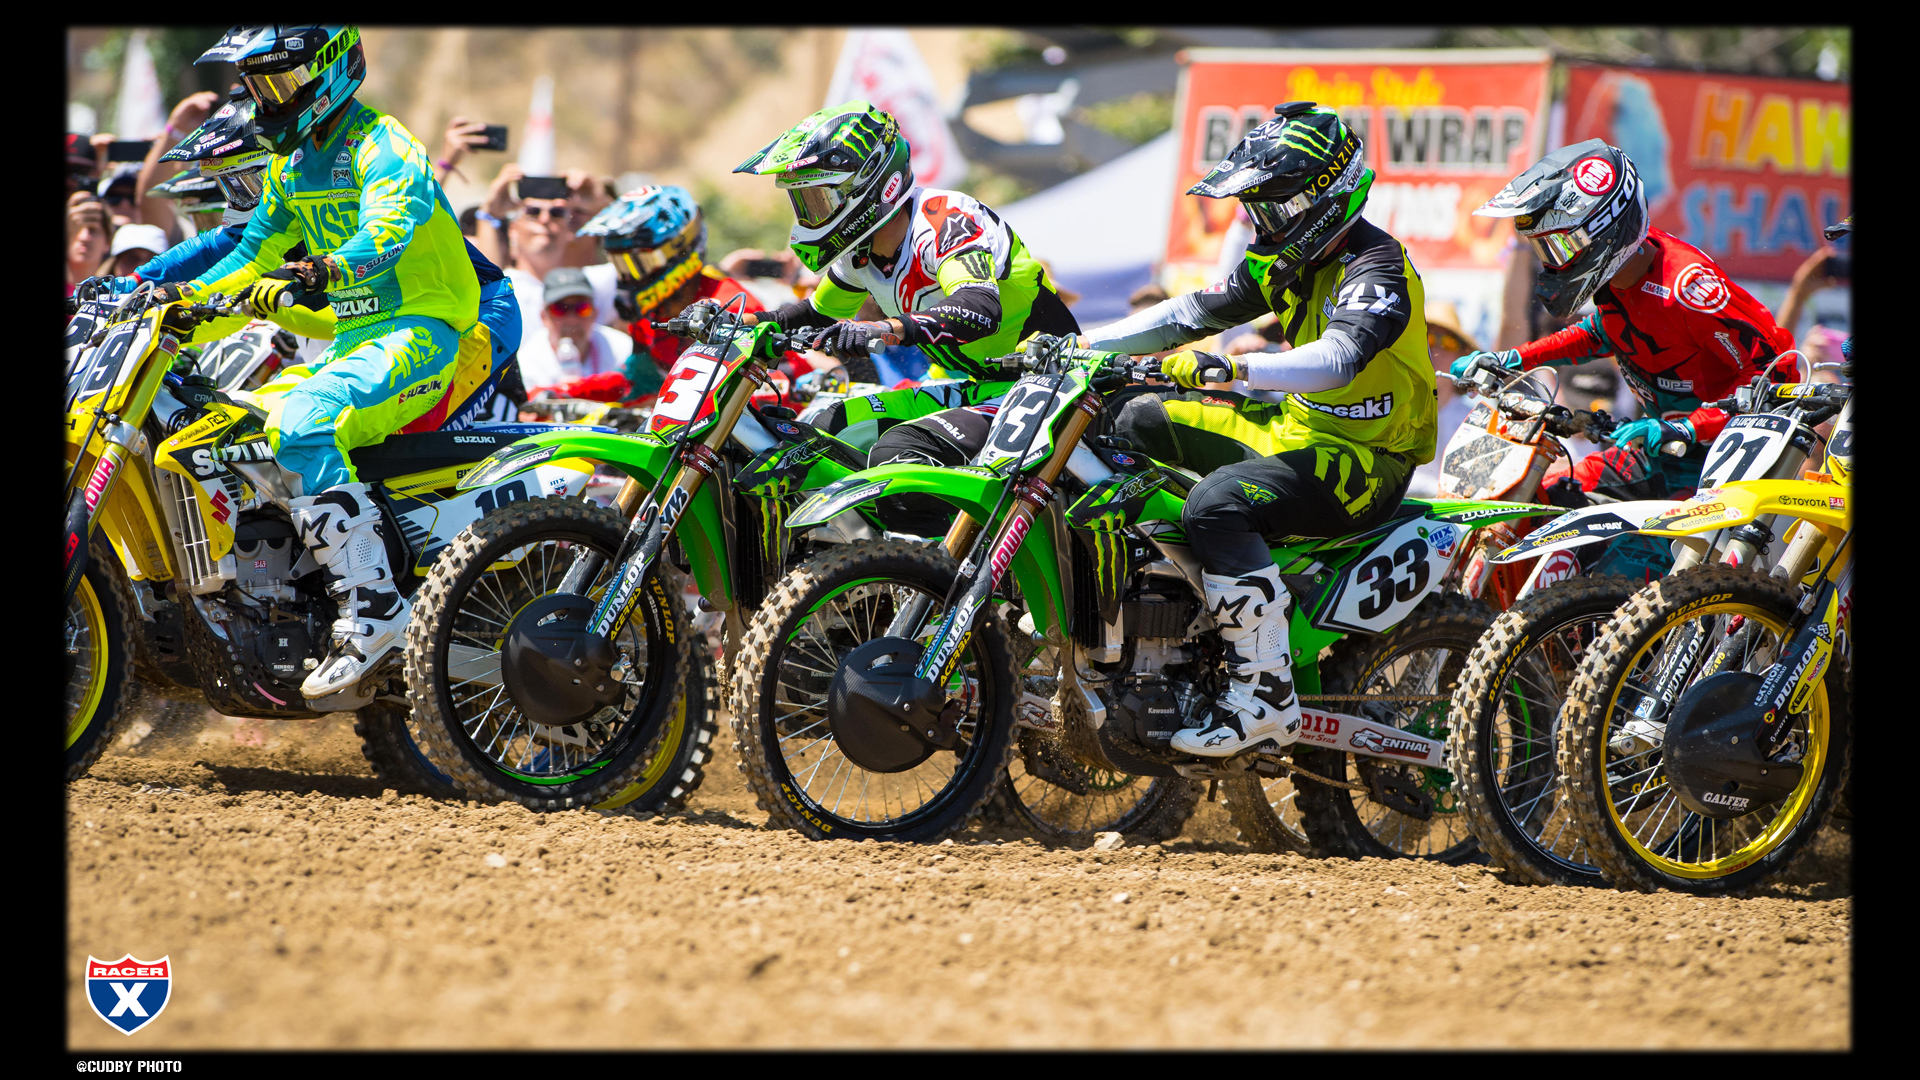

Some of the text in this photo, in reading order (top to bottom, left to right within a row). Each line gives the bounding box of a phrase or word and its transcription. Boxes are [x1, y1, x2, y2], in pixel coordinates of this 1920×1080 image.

[246, 51, 289, 66] SHIMANO
[201, 135, 226, 150] THOR
[1384, 107, 1531, 172] WRAP
[885, 176, 900, 199] BELL
[842, 203, 879, 236] MONSTER
[1297, 203, 1341, 245] MONSTER
[365, 243, 405, 271] SUZUKI
[929, 306, 992, 328] MONSTER
[939, 312, 982, 332] ENERGY
[704, 346, 719, 358] OIL
[405, 380, 442, 398] SUZUK
[1037, 376, 1051, 387] OIL
[1755, 417, 1770, 428] OIL
[453, 436, 496, 444] SUZUKI
[1700, 432, 1772, 490] 21
[85, 456, 117, 523] HOWA
[1791, 497, 1828, 508] TOYOTA
[1681, 513, 1725, 529] Autotrader
[1356, 537, 1431, 621] 33
[596, 551, 646, 638] DUNLOP
[649, 576, 675, 645] DUNLOP
[1664, 593, 1734, 625] DUNLOP
[925, 594, 976, 684] DUNLOP
[1488, 634, 1530, 703] DUNLOP
[1774, 637, 1819, 711] DUNLOP
[1147, 707, 1175, 716] Kawasaki
[1350, 728, 1431, 754] RENTHAL
[780, 782, 834, 835] DUNLOP
[1702, 791, 1750, 809] GALFER
